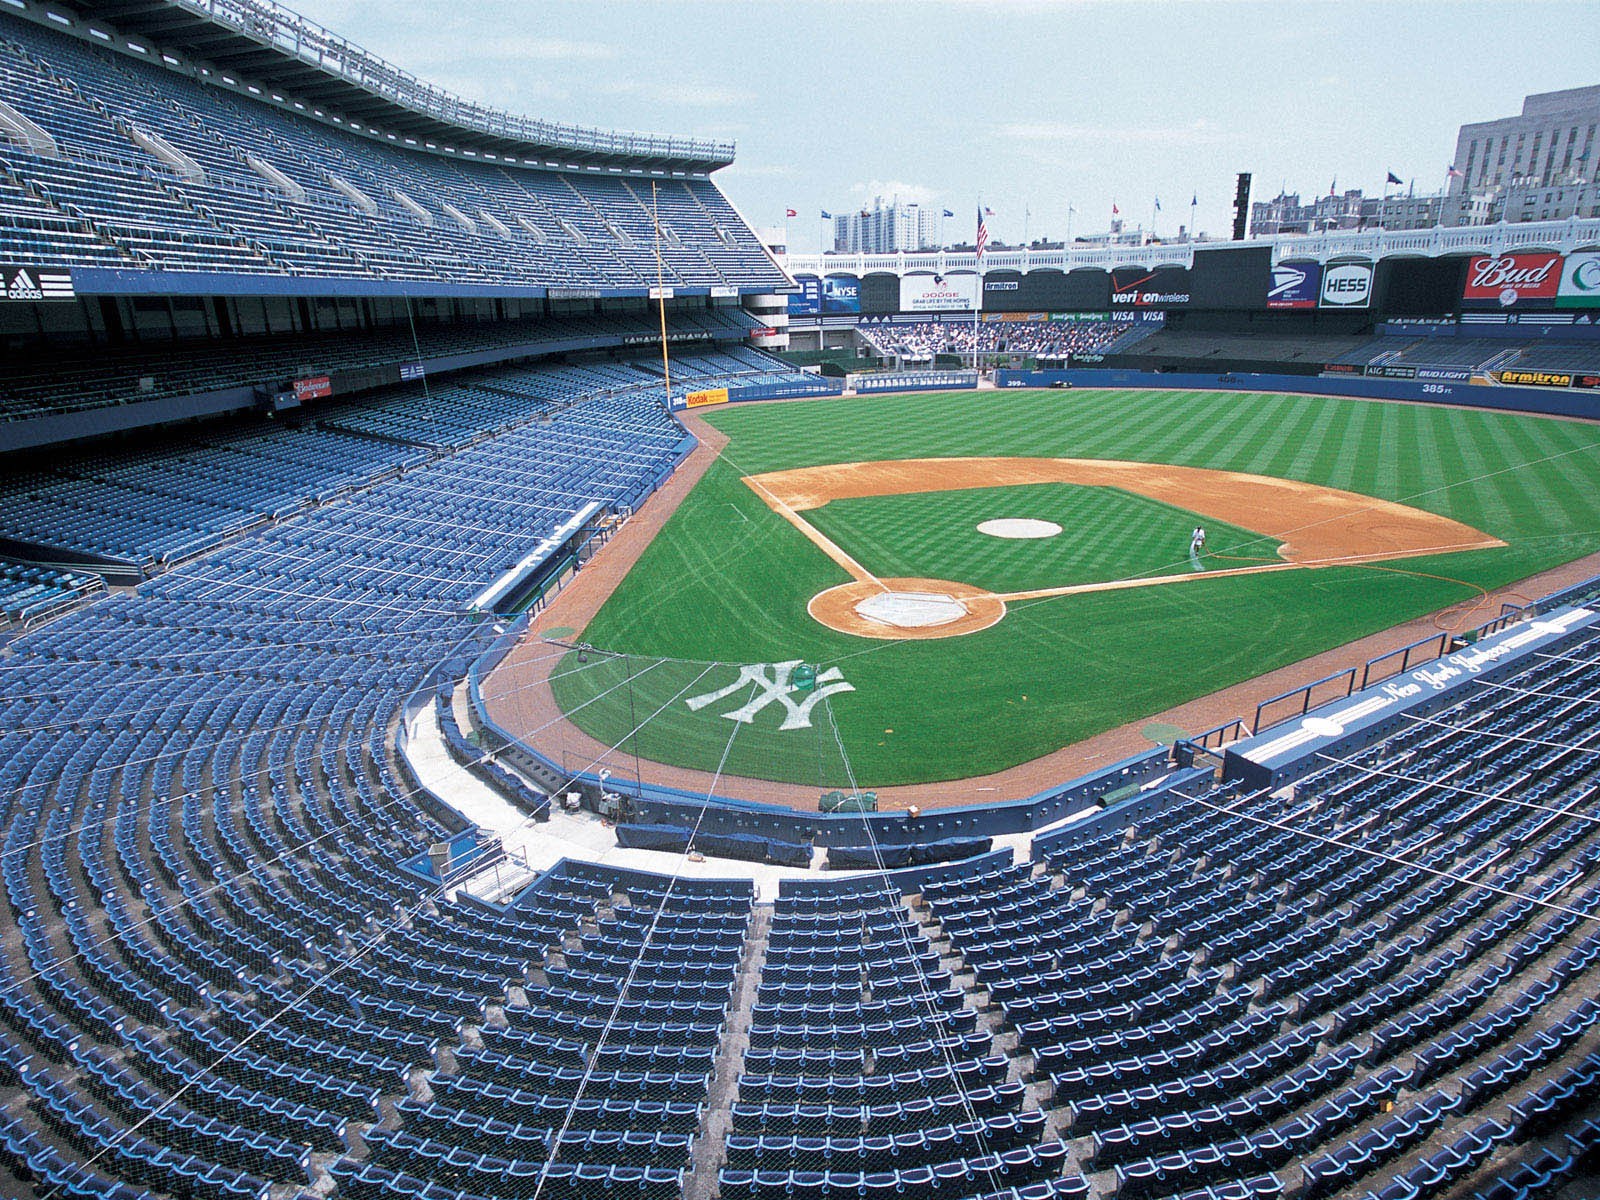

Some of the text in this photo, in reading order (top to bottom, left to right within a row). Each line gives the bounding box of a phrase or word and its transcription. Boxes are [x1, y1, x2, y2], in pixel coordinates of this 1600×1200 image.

[1471, 257, 1557, 288] Bud
[986, 282, 1017, 290] Armitron
[1326, 278, 1367, 292] HESS
[8, 287, 42, 299] adidas
[834, 286, 857, 296] NYSE
[1112, 311, 1134, 321] VISA
[1142, 311, 1164, 321] VISA
[1368, 367, 1382, 375] AIG
[1418, 370, 1440, 378] BUD
[1439, 371, 1469, 379] LIGHT
[1502, 371, 1570, 383] Armitron
[1422, 384, 1444, 394] 385
[687, 393, 708, 405] Kodak
[1381, 645, 1510, 702] New York Yankees
